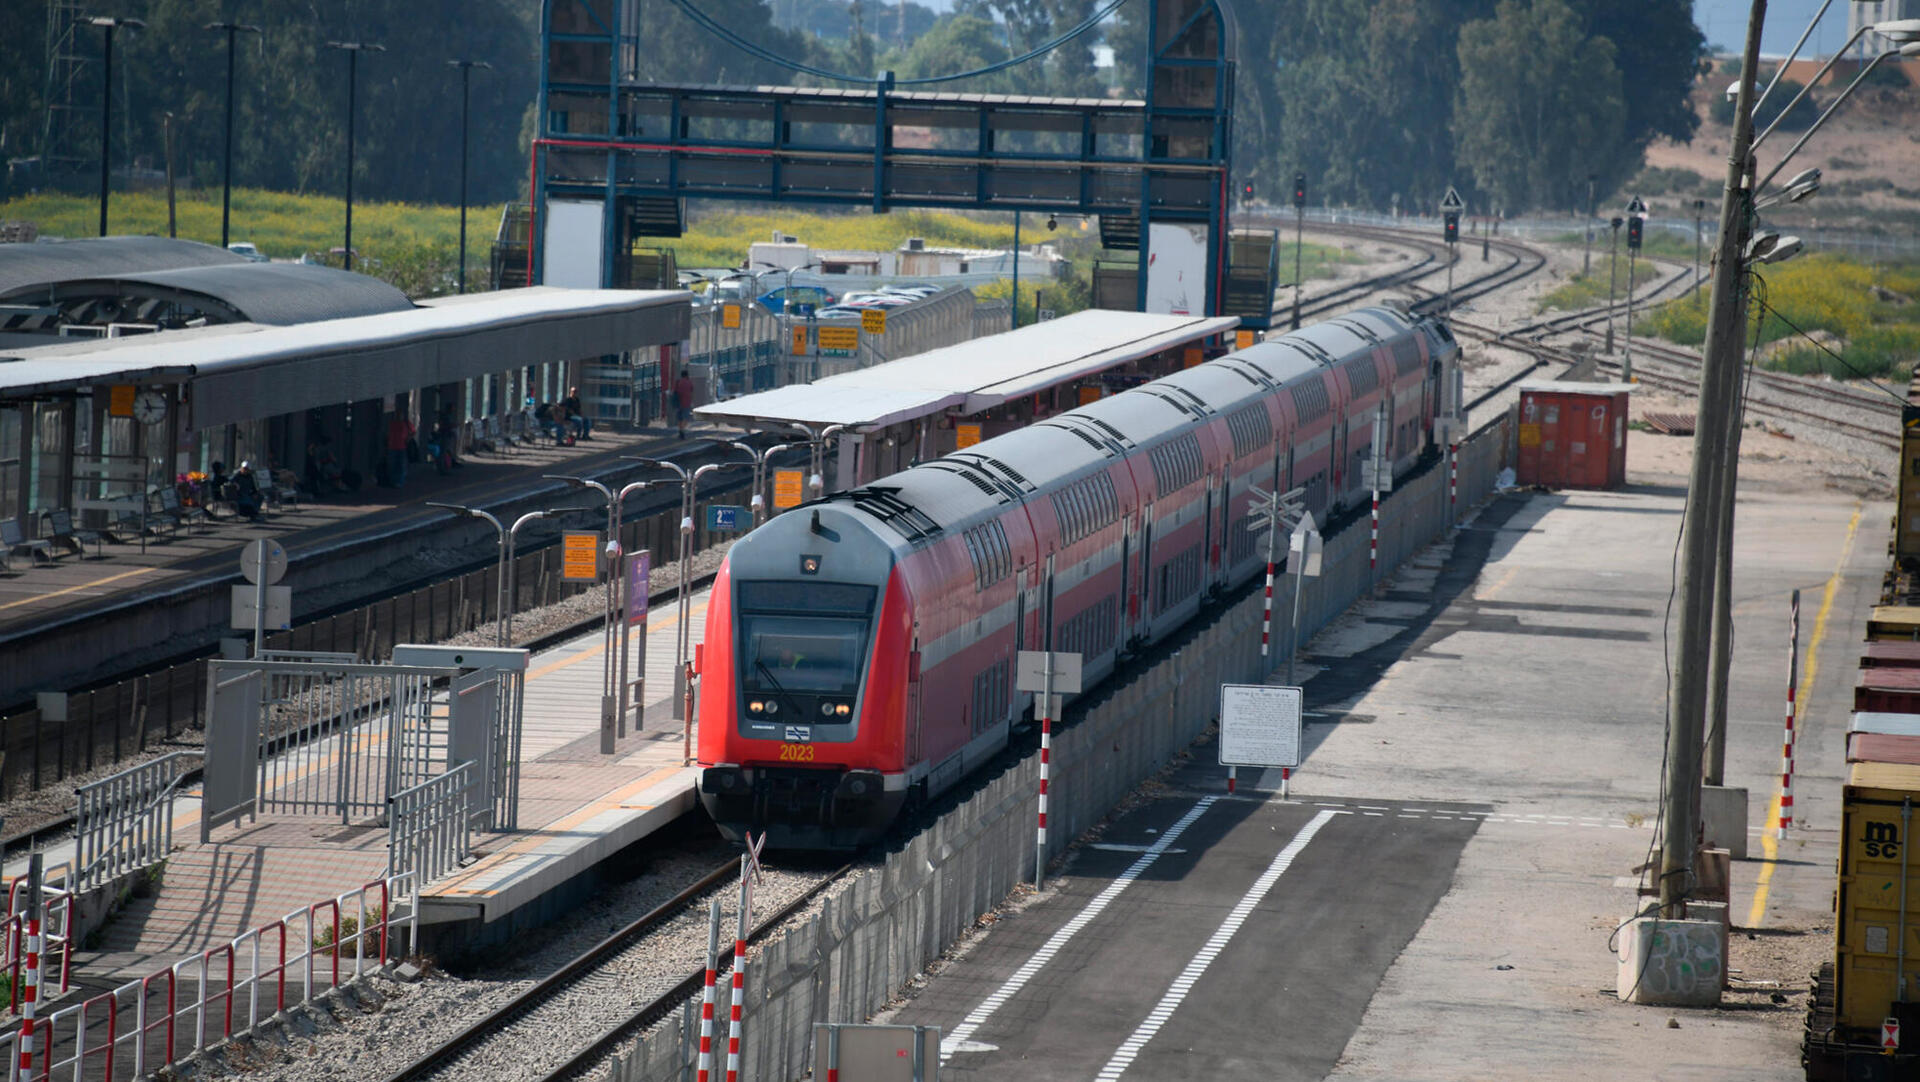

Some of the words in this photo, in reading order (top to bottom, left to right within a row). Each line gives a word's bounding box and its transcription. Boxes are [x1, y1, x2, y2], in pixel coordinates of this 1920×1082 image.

[1592, 405, 1607, 433] 9
[716, 509, 723, 524] 2
[780, 743, 815, 761] 2023
